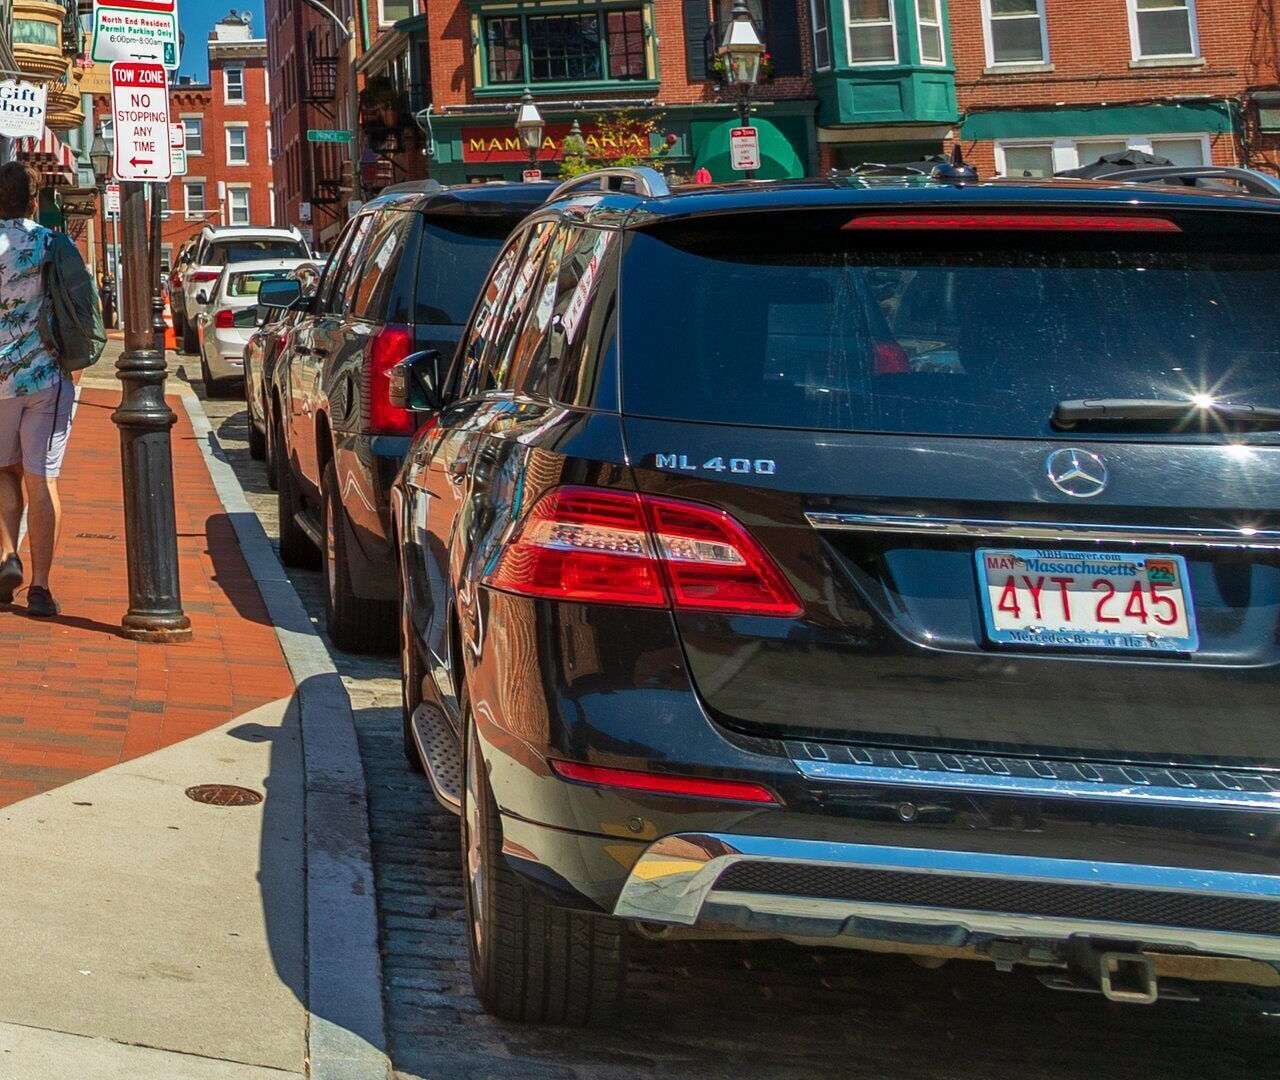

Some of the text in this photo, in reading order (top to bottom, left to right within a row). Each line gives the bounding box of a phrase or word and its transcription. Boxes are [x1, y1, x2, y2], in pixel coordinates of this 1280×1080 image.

[101, 15, 171, 28] North End Resident
[100, 24, 172, 38] Permit Parking Only
[114, 69, 134, 82] TOW
[139, 70, 164, 84] ZONE
[131, 94, 151, 108] NO
[118, 110, 166, 123] STOPPING
[133, 126, 152, 137] ANY
[133, 141, 156, 153] TIME
[469, 133, 645, 152] MAMA ARIA
[1036, 549, 1121, 561] MBHanover.com
[987, 557, 1015, 570] MAY
[1025, 558, 1136, 577] Massachusetts
[1151, 565, 1170, 579] 22
[998, 575, 1178, 625] 4YT 245
